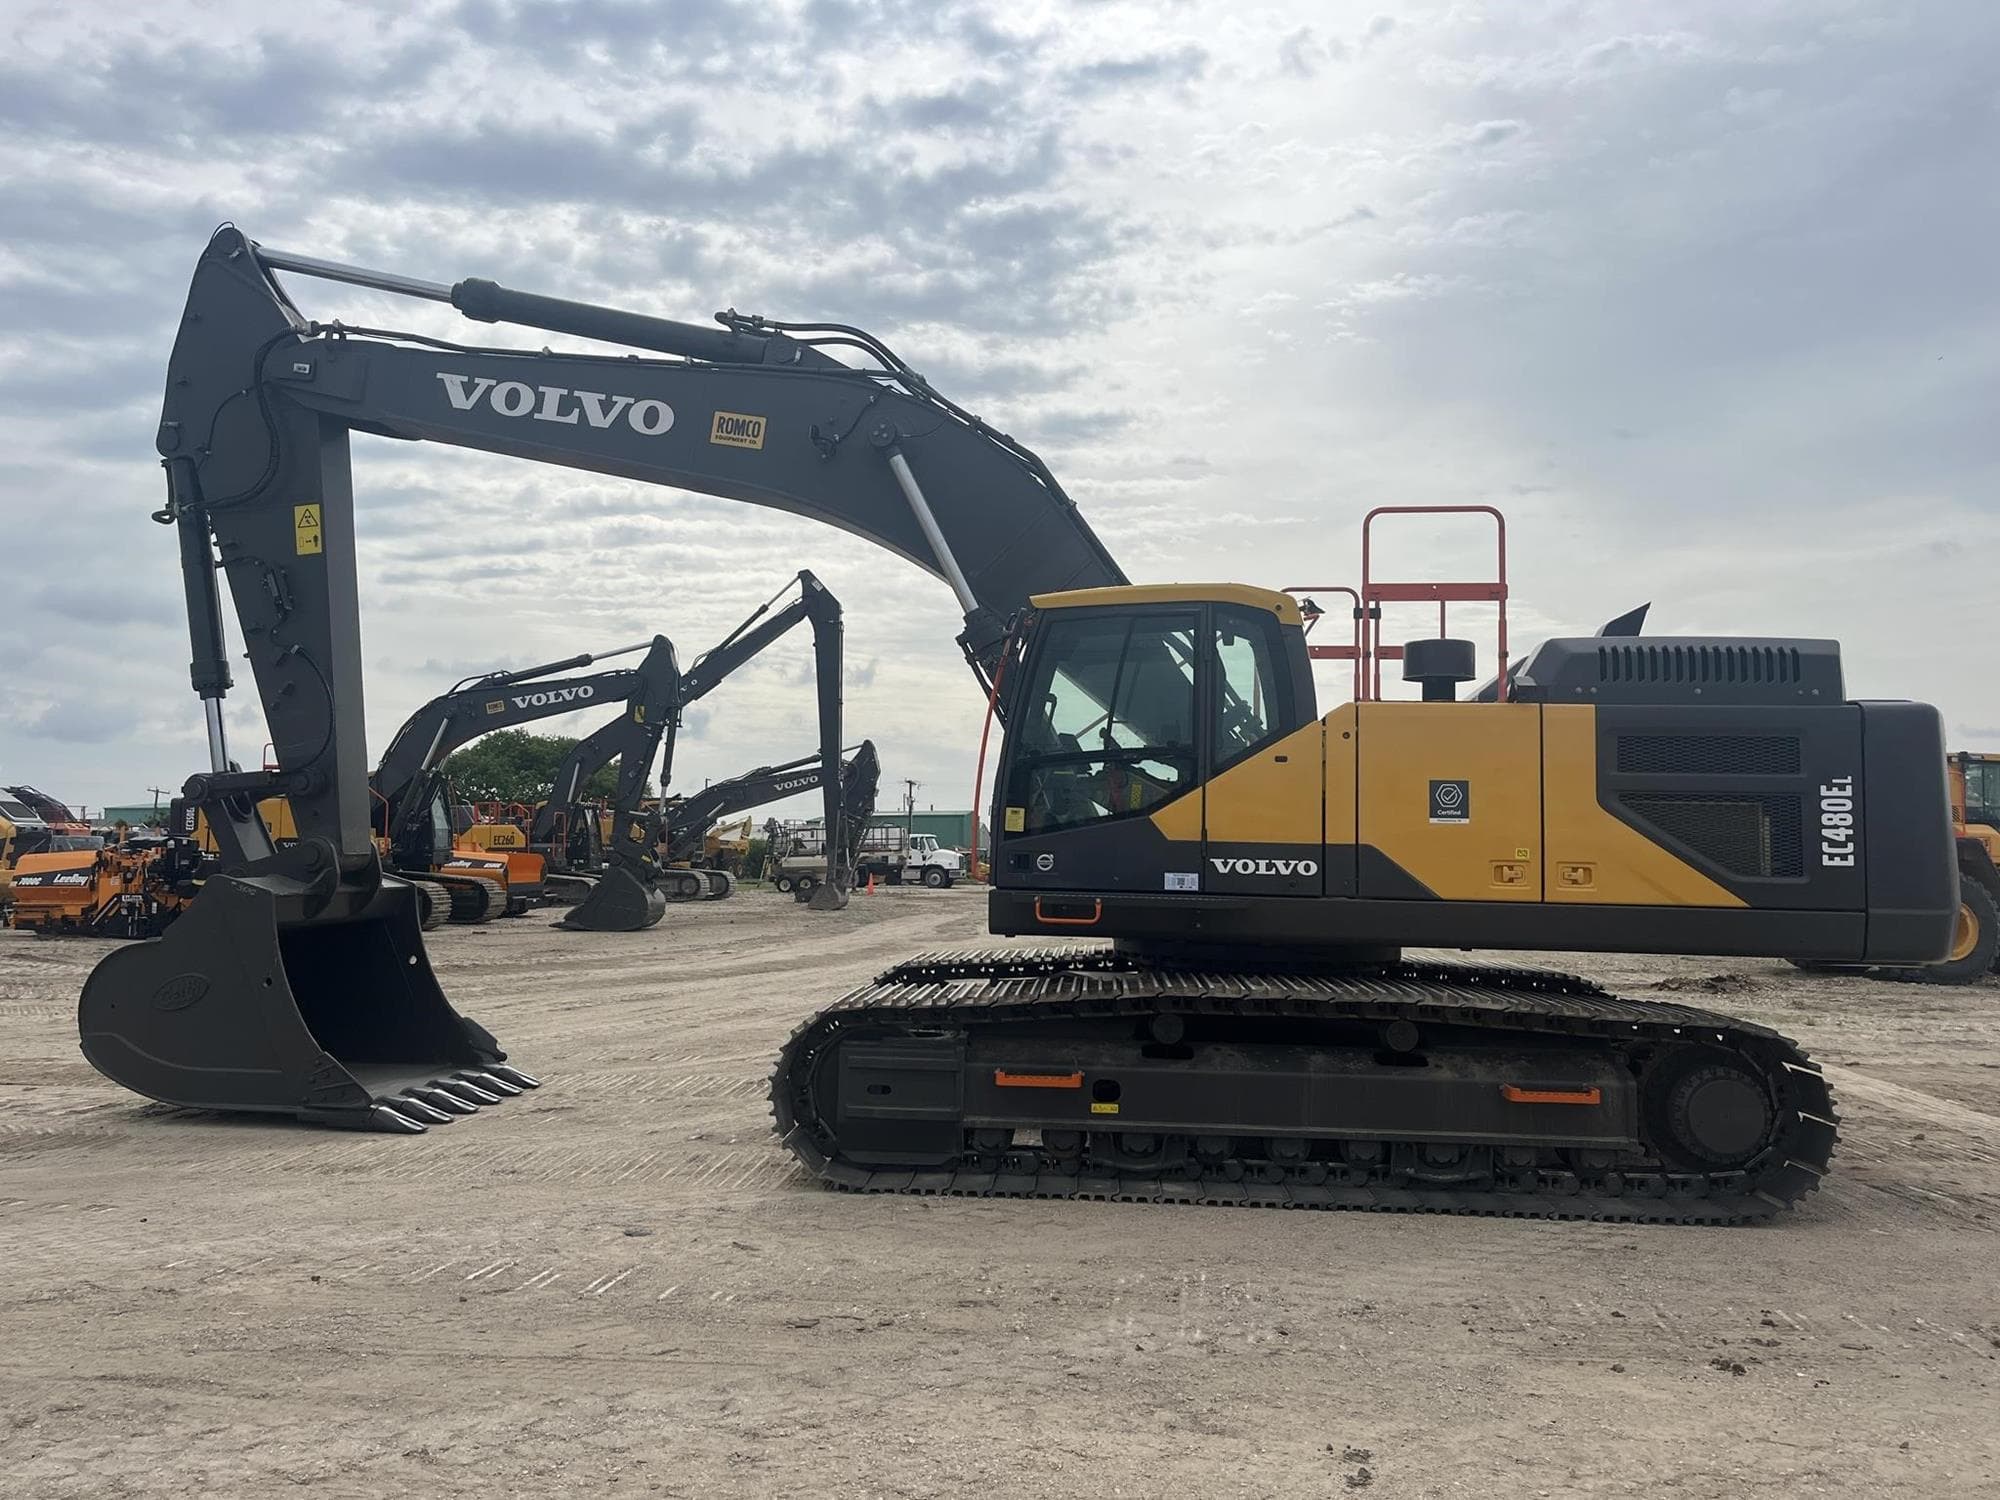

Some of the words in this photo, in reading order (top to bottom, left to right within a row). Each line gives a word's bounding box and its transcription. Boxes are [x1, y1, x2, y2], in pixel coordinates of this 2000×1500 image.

[436, 372, 675, 435] VOLVO
[717, 416, 761, 438] ROMCO
[511, 685, 594, 708] VOLVO
[773, 775, 819, 791] VOLVO
[493, 835, 515, 846] EC260
[1210, 858, 1318, 876] VOLVO
